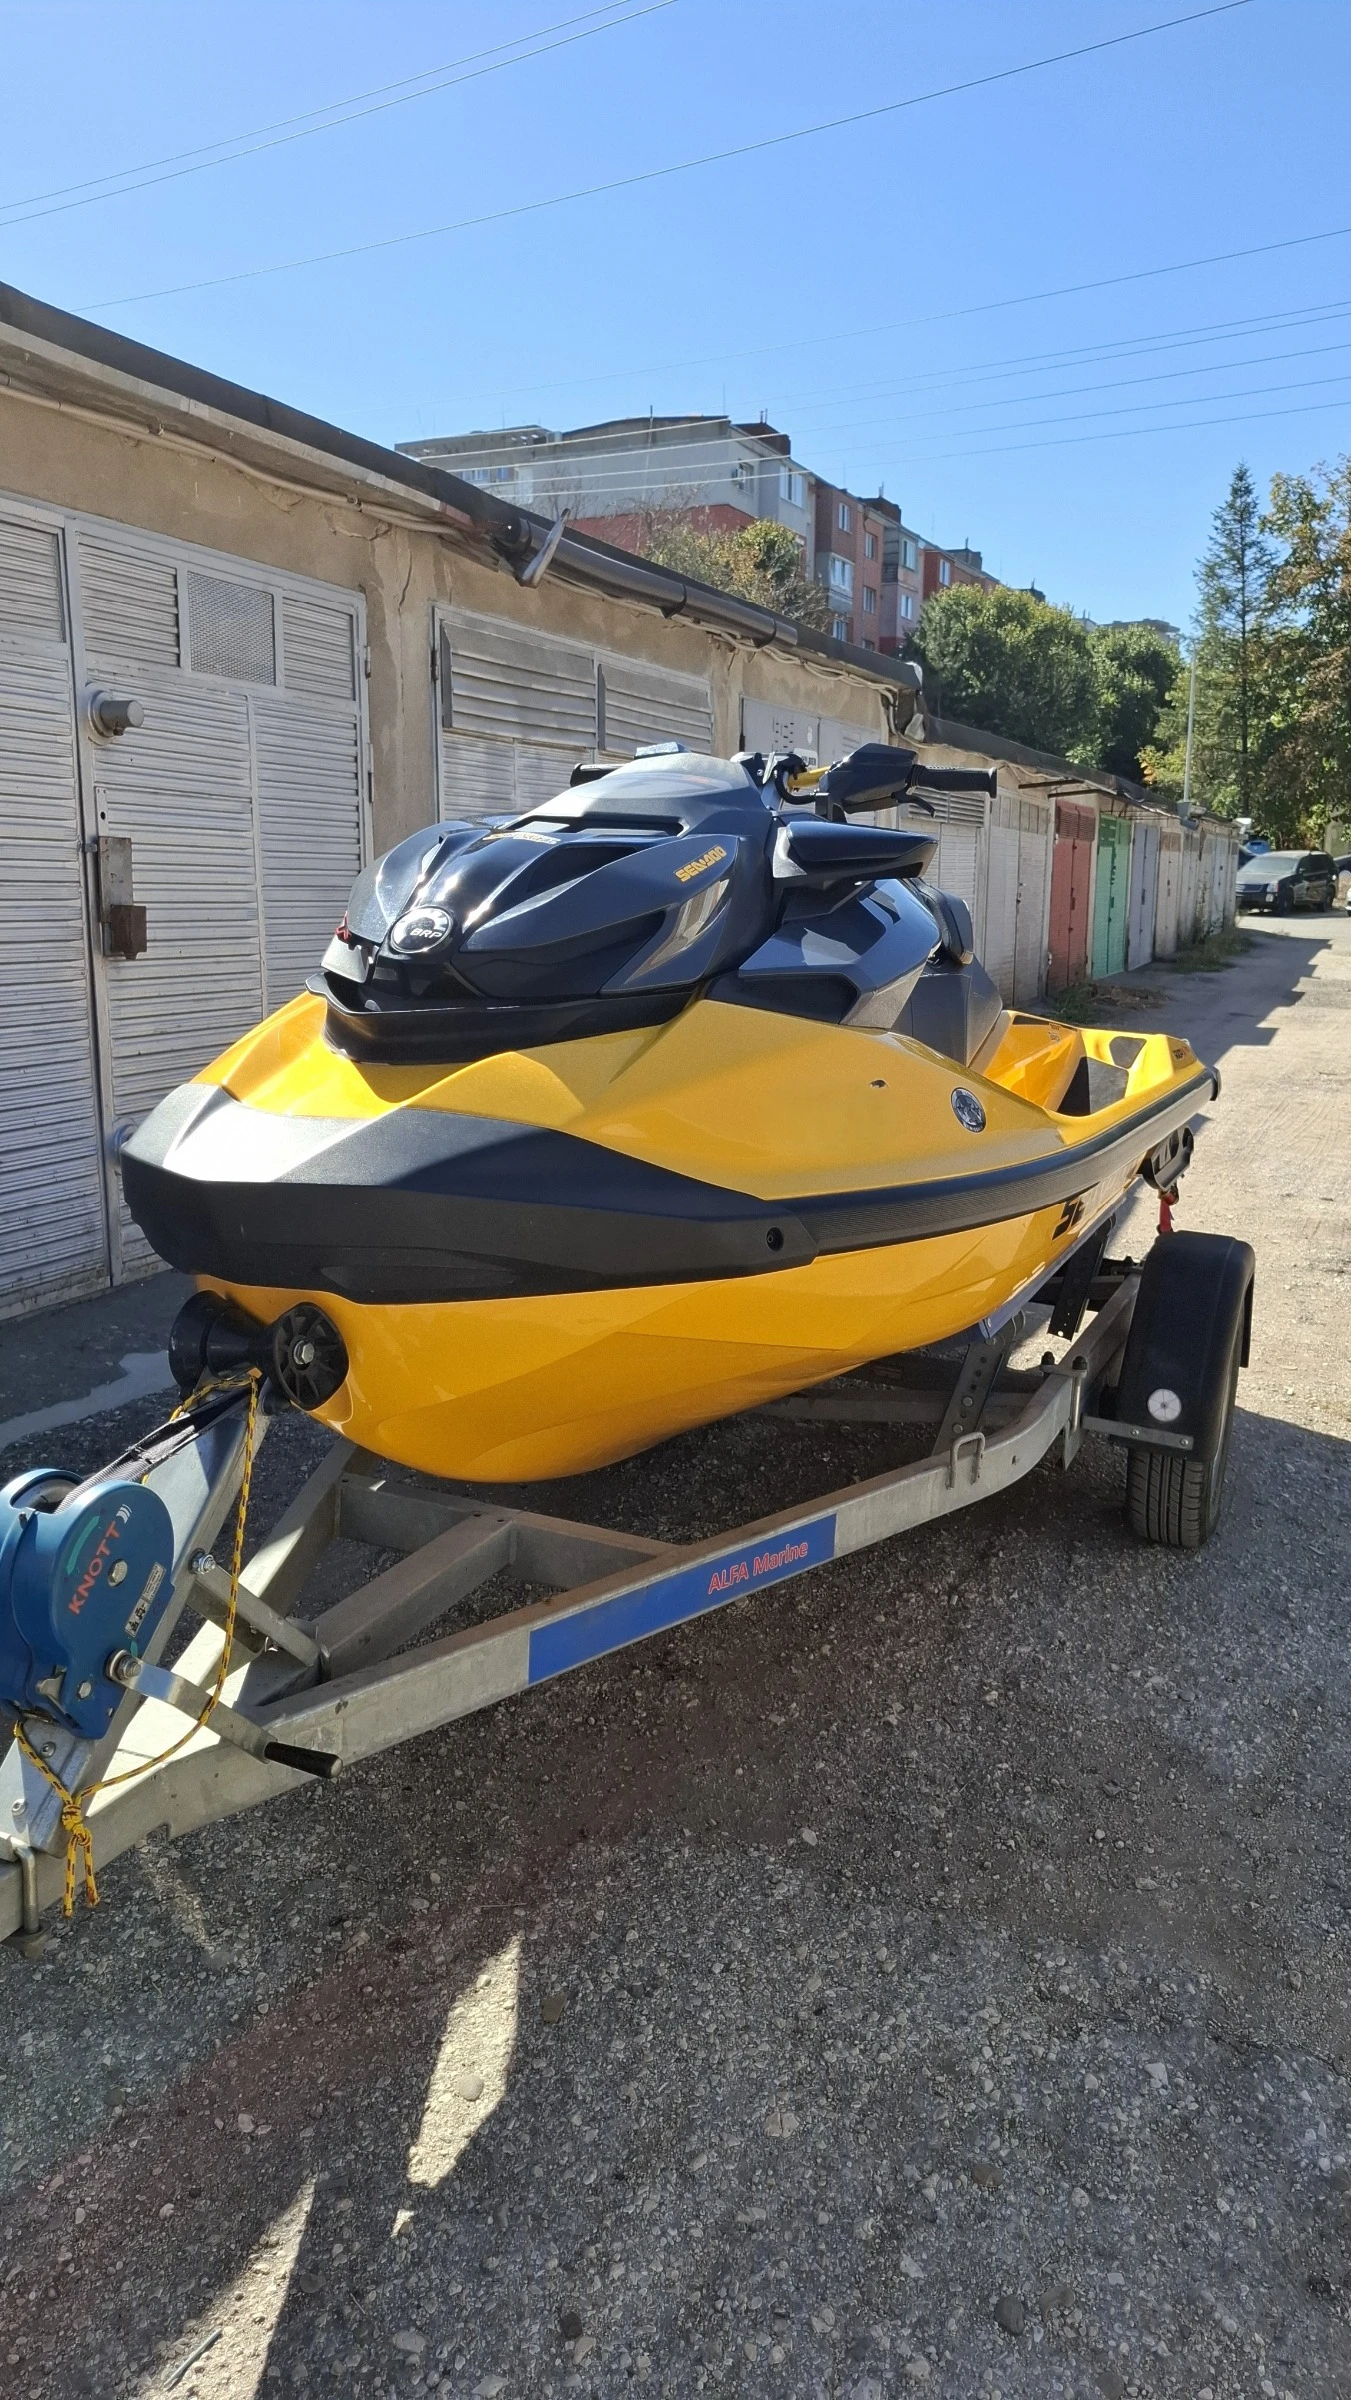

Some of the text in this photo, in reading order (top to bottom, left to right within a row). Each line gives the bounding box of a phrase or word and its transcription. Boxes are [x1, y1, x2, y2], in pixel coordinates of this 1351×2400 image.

[409, 928, 443, 938] BRP
[68, 1520, 121, 1615] KNOTT
[707, 1541, 808, 1595] ALFA Marine
